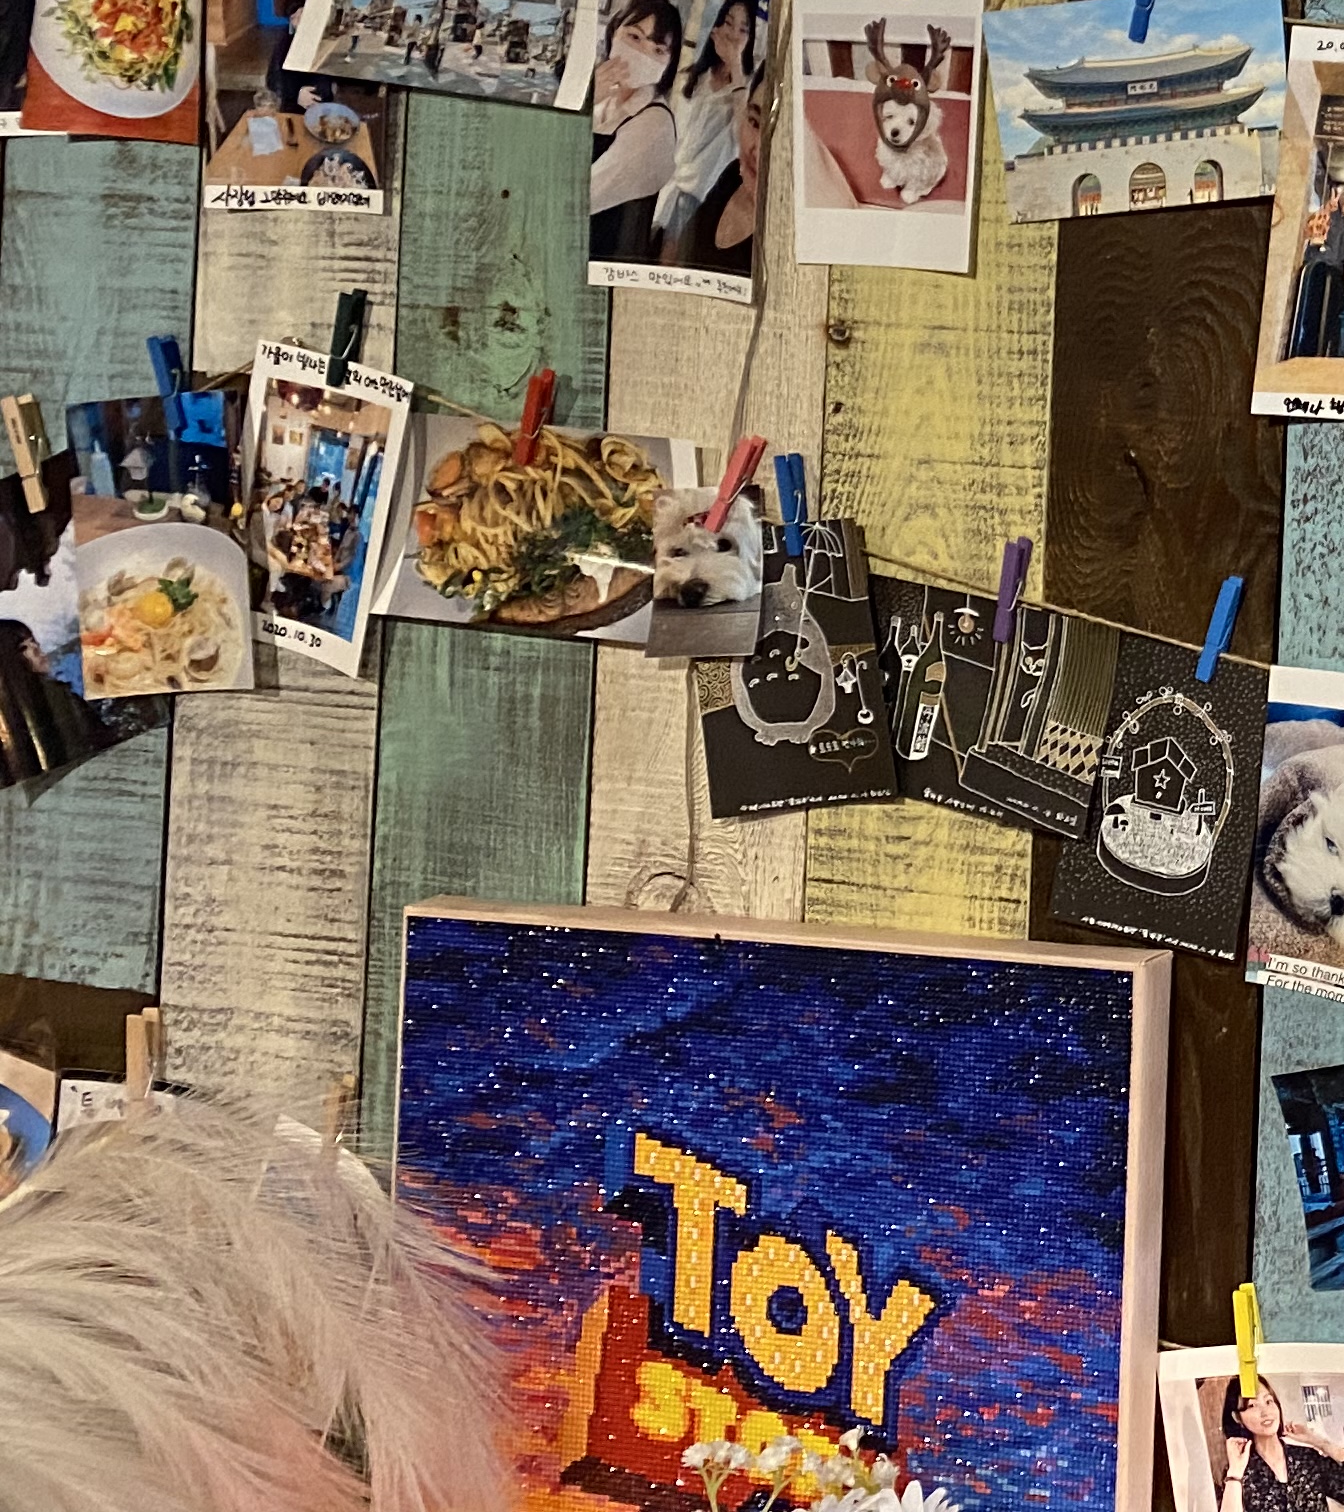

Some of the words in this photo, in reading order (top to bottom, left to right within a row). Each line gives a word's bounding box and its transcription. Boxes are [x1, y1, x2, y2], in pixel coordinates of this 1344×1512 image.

[1268, 957, 1289, 972] I'm
[1292, 964, 1308, 975] so
[1265, 974, 1290, 989] For
[1292, 981, 1313, 995] the
[634, 1131, 936, 1426] TOY
